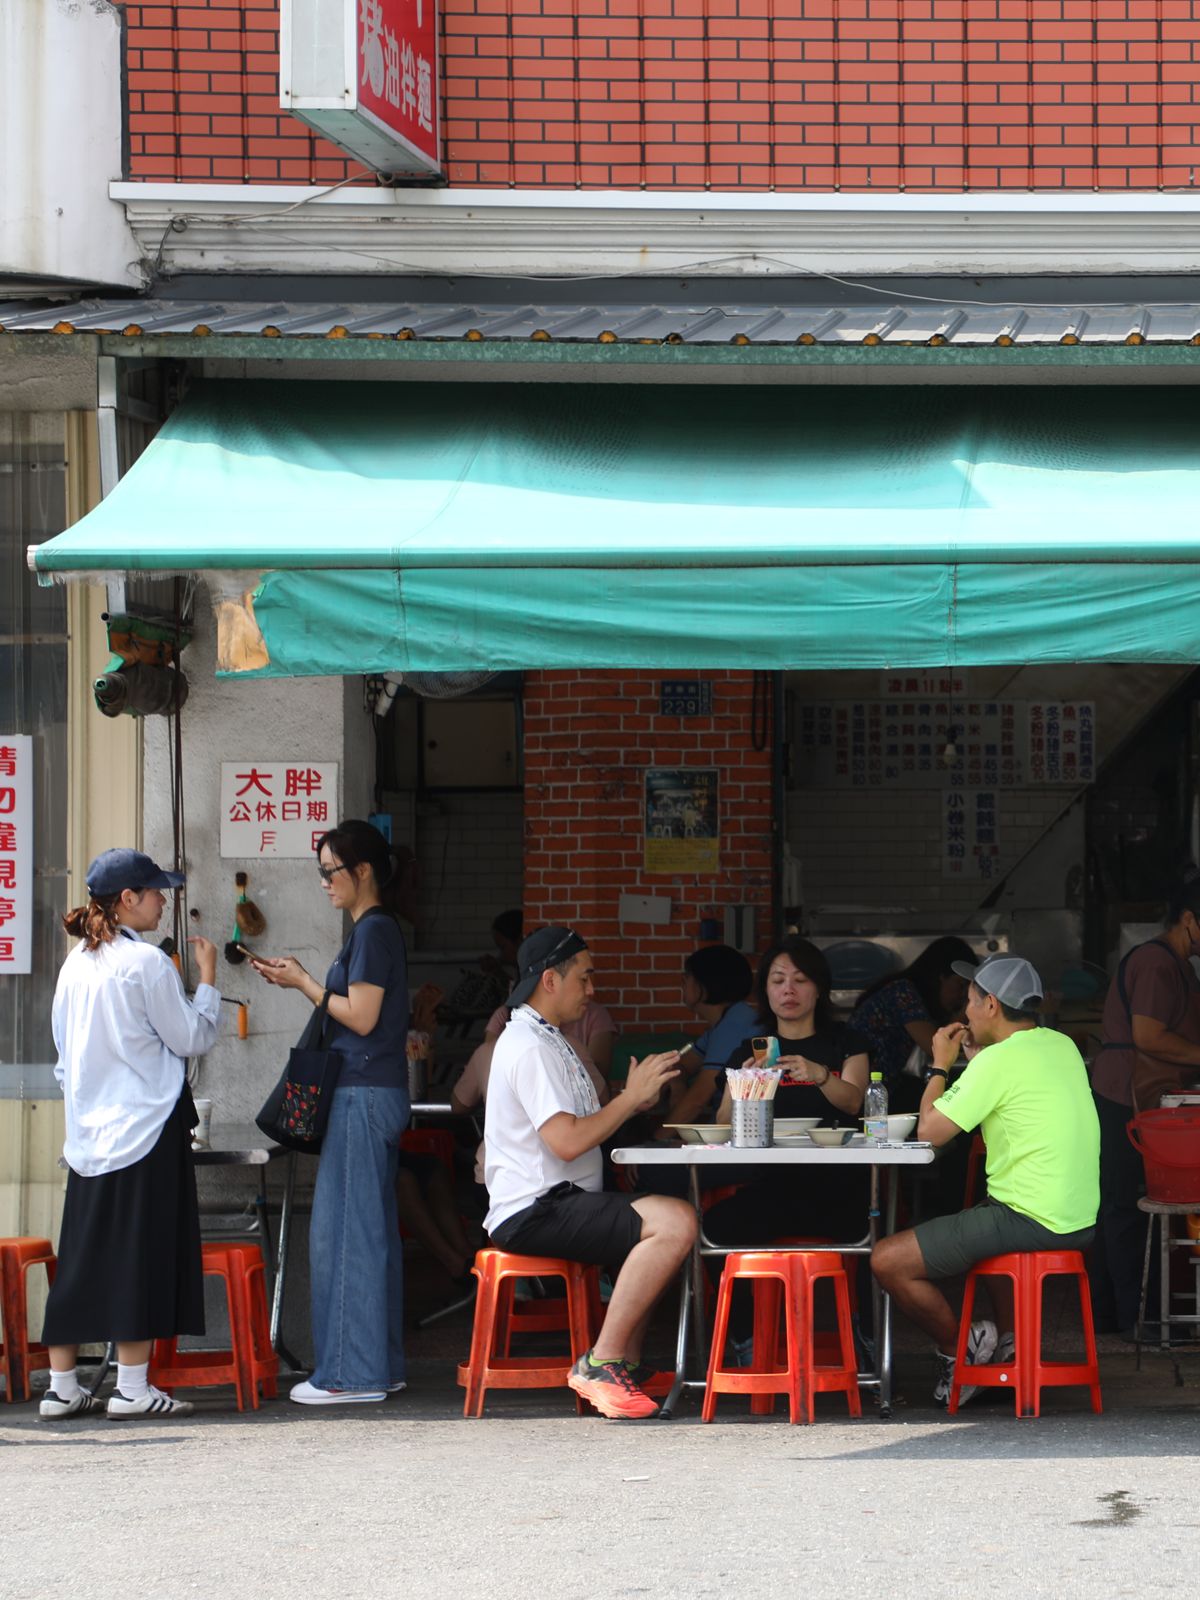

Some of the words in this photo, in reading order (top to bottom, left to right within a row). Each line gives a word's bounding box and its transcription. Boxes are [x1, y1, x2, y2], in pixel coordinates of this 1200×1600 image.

[663, 700, 696, 714] 229
[984, 759, 997, 771] 45
[235, 768, 322, 796] 大胖
[984, 773, 998, 785] 55
[229, 801, 328, 822] 公休日期
